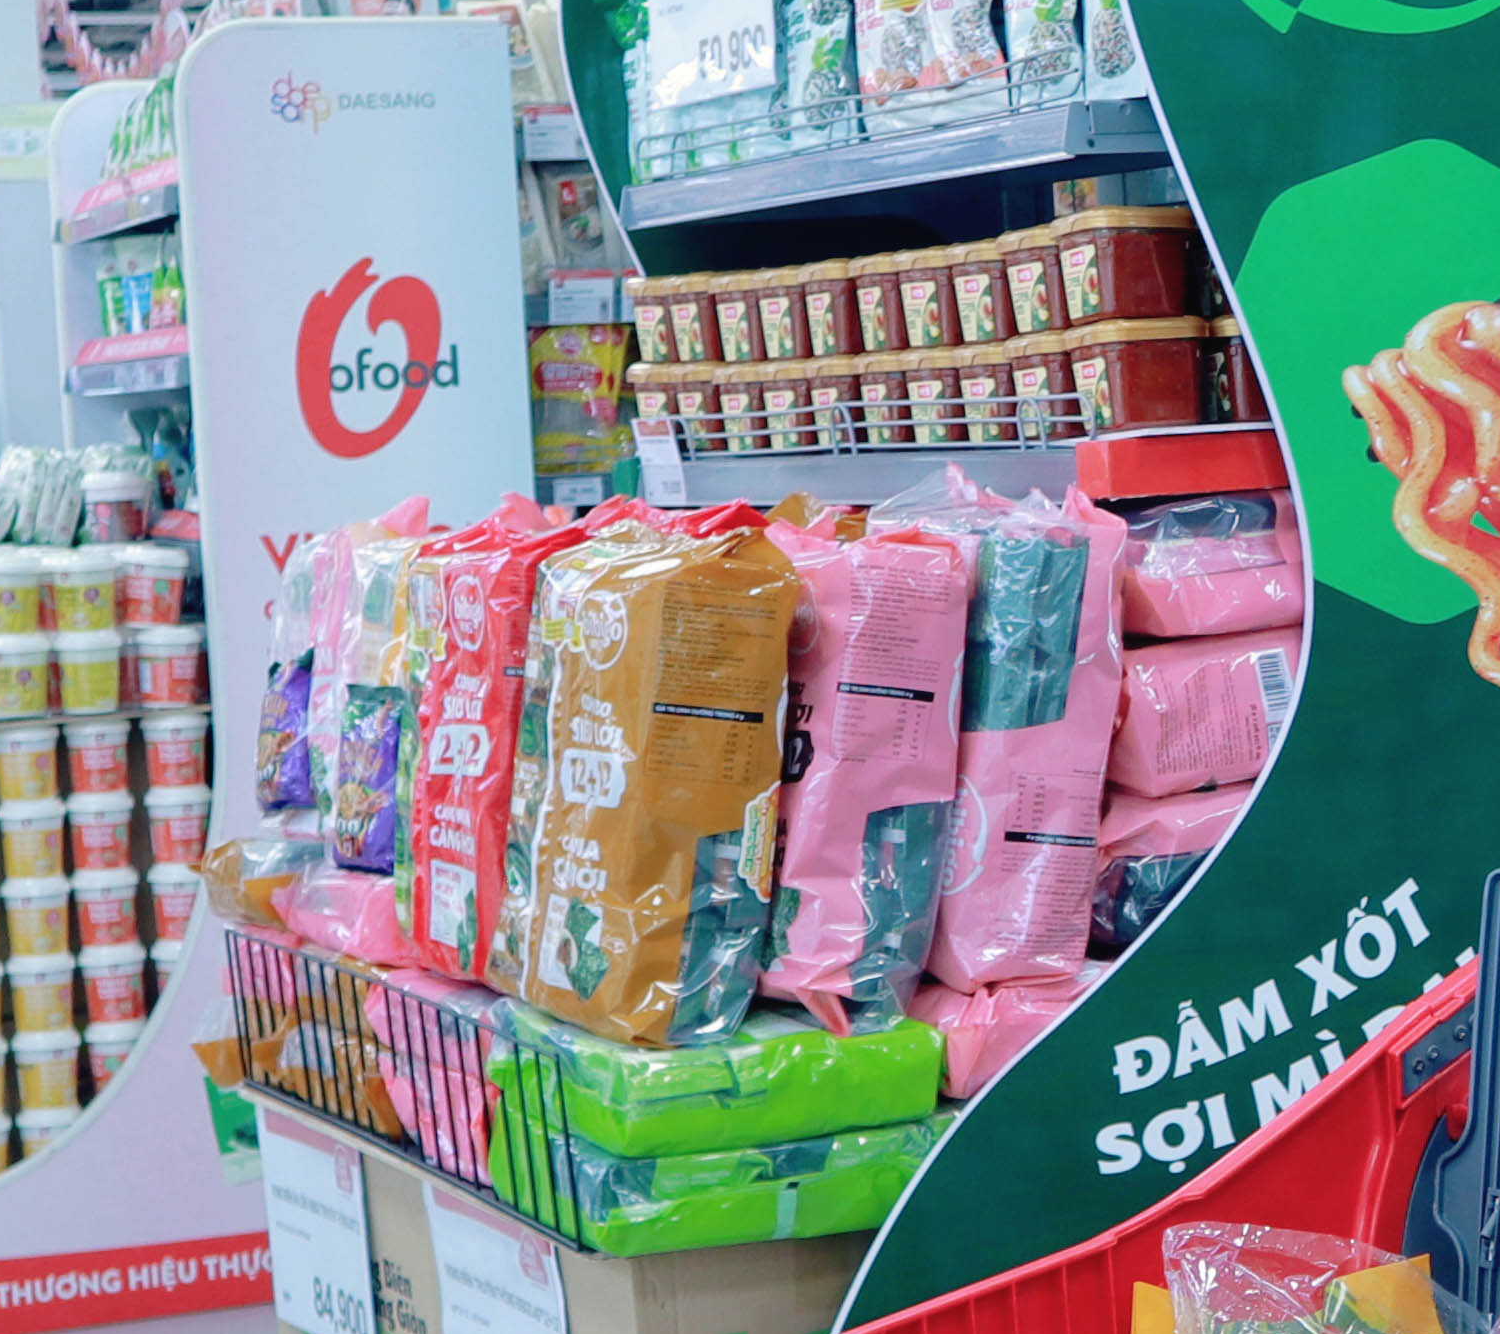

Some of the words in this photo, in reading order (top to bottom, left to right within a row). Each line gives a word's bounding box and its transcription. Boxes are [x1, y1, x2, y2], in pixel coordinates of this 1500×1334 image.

[338, 91, 436, 111] DAESANG
[329, 344, 459, 394] ofood
[1112, 978, 1294, 1095] ĐẪM
[1295, 878, 1431, 1017] XỐT
[1095, 1093, 1236, 1175] SỢI
[128, 1259, 197, 1294] HIỆU
